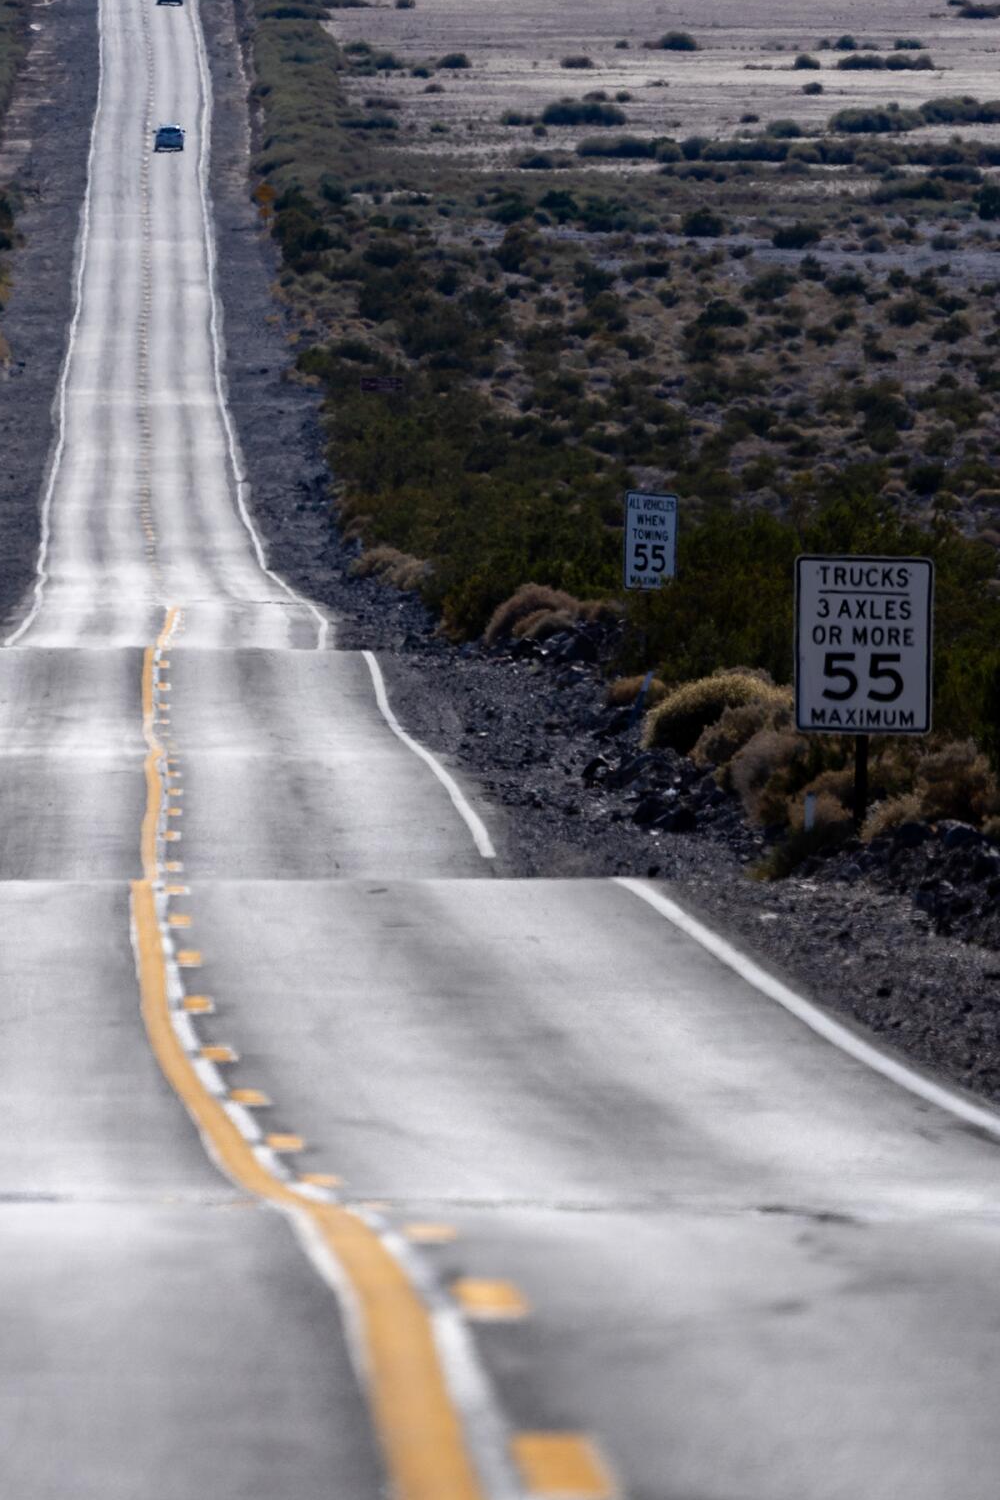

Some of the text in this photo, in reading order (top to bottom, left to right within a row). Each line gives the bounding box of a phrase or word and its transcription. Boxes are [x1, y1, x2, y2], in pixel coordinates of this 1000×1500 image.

[637, 514, 666, 526] WHEN
[632, 528, 669, 542] TOWING
[633, 543, 666, 573] 55
[819, 565, 909, 588] TRUCKS
[816, 598, 912, 620] 3 AXLES
[812, 625, 914, 647] OR MORE
[822, 652, 904, 703] 55
[810, 707, 915, 726] MAXIMUM
